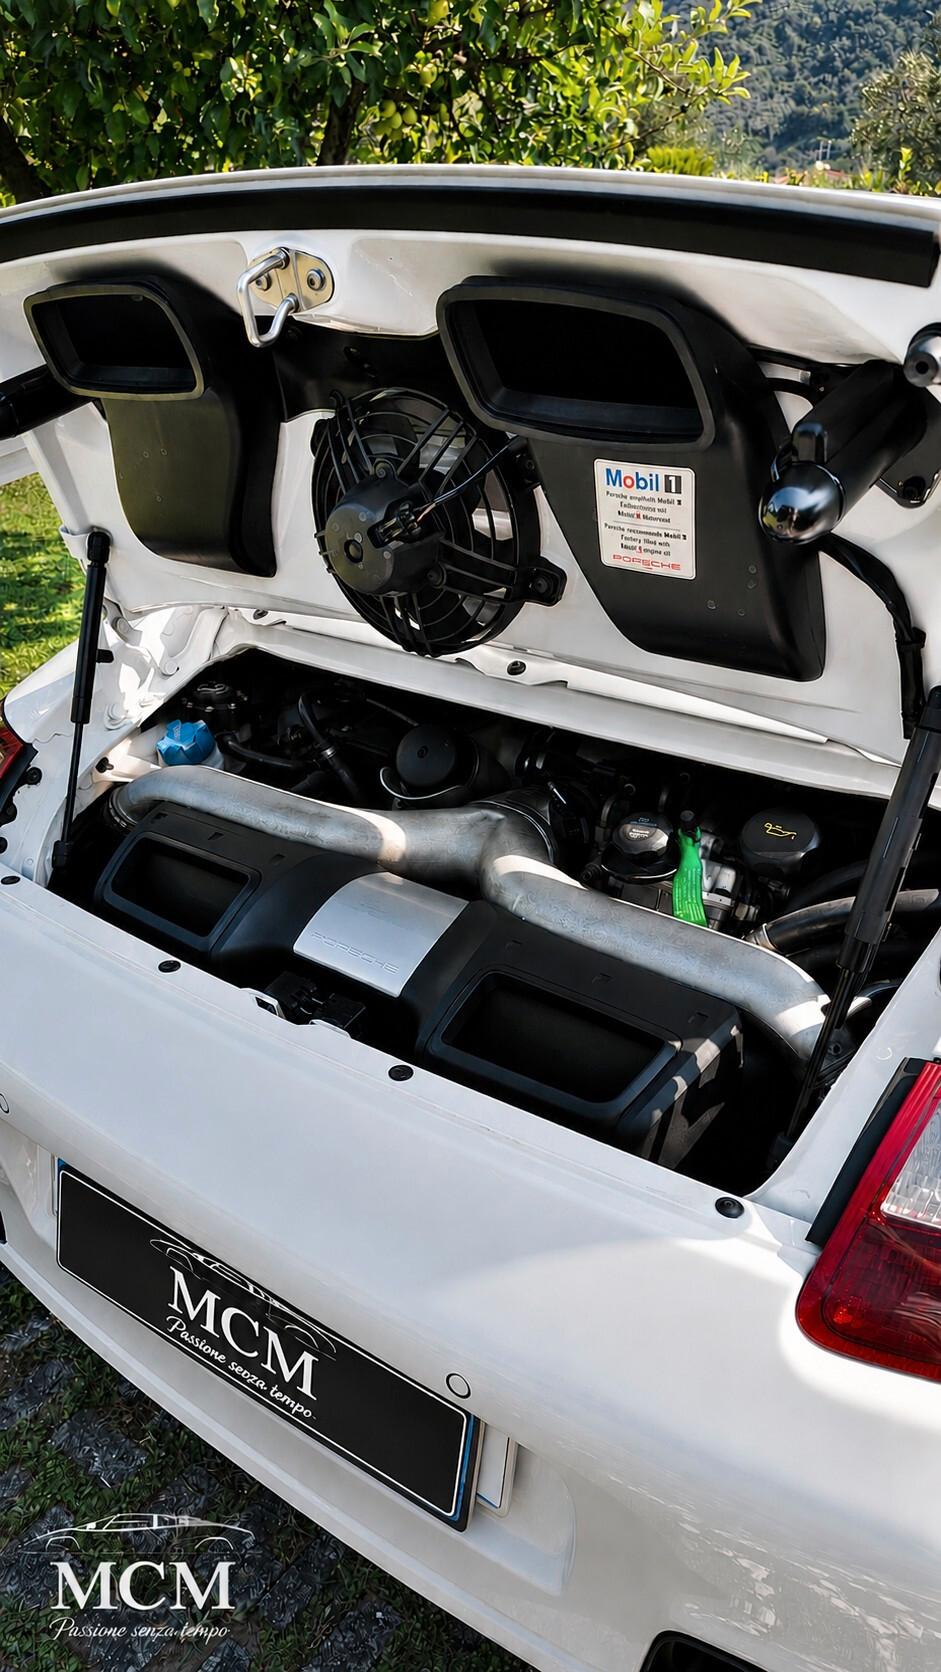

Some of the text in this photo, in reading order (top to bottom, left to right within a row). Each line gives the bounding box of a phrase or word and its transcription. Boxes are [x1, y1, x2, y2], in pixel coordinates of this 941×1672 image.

[606, 467, 660, 492] Mobil
[612, 554, 681, 571] PORSCHE
[312, 931, 400, 974] PORSCHE
[166, 1315, 227, 1364] Passione
[167, 1265, 320, 1401] MCM
